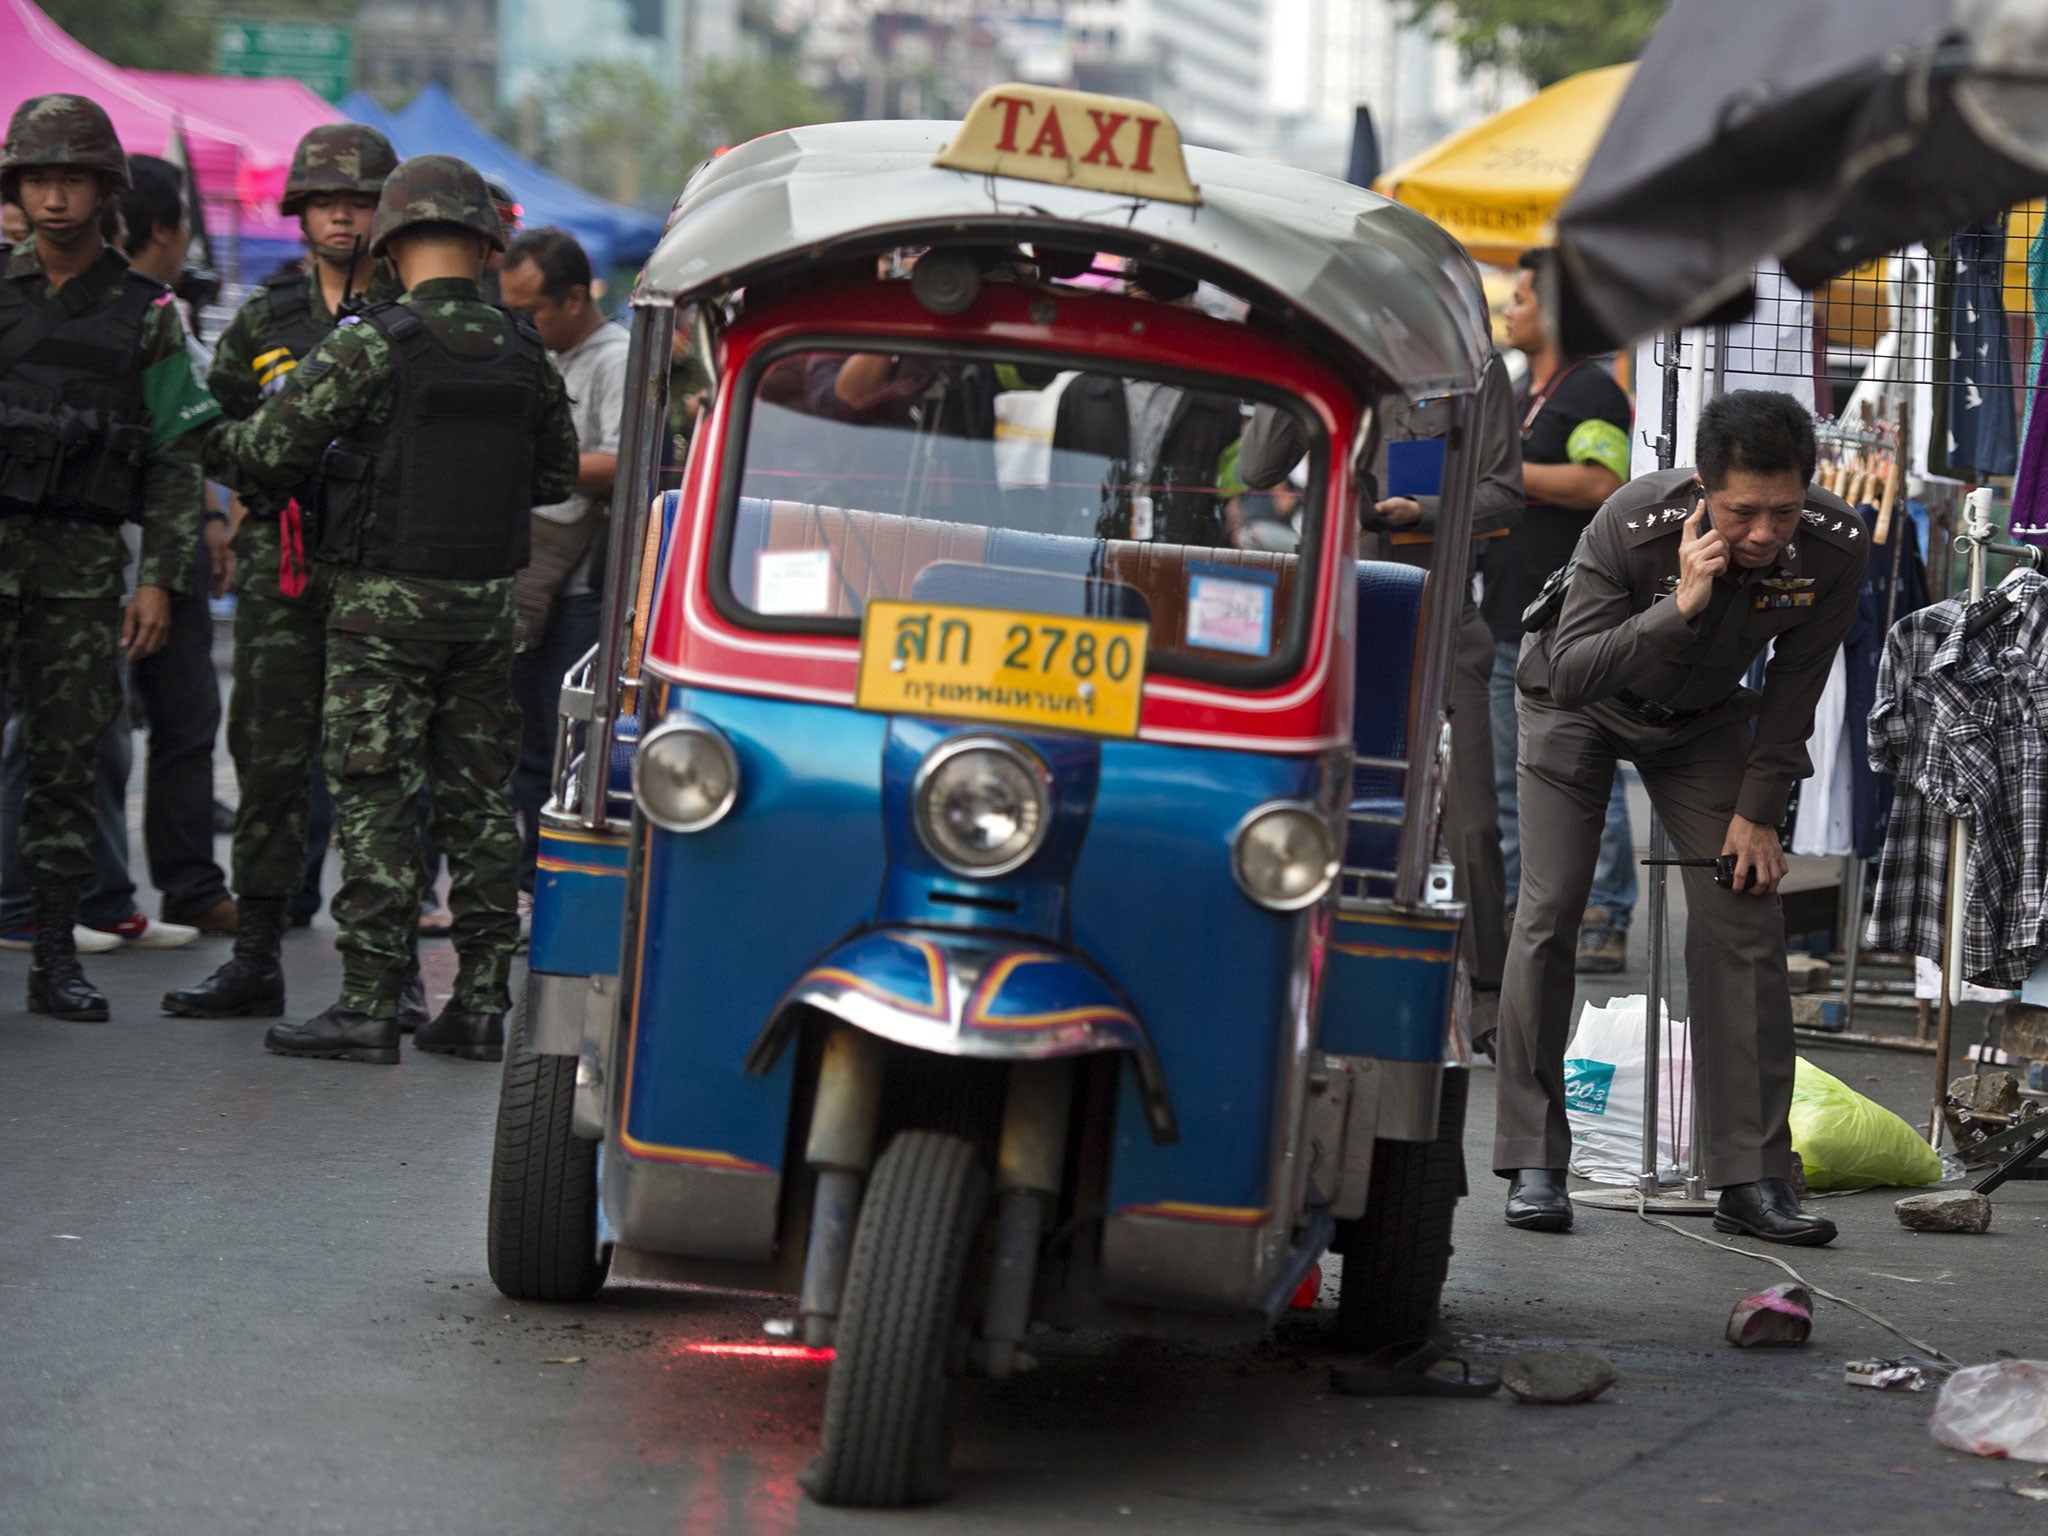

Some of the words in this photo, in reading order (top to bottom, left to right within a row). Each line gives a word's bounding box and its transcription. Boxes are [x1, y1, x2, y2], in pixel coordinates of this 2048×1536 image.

[990, 94, 1162, 173] TAXI
[895, 613, 971, 664] สก
[1003, 624, 1131, 682] 2780
